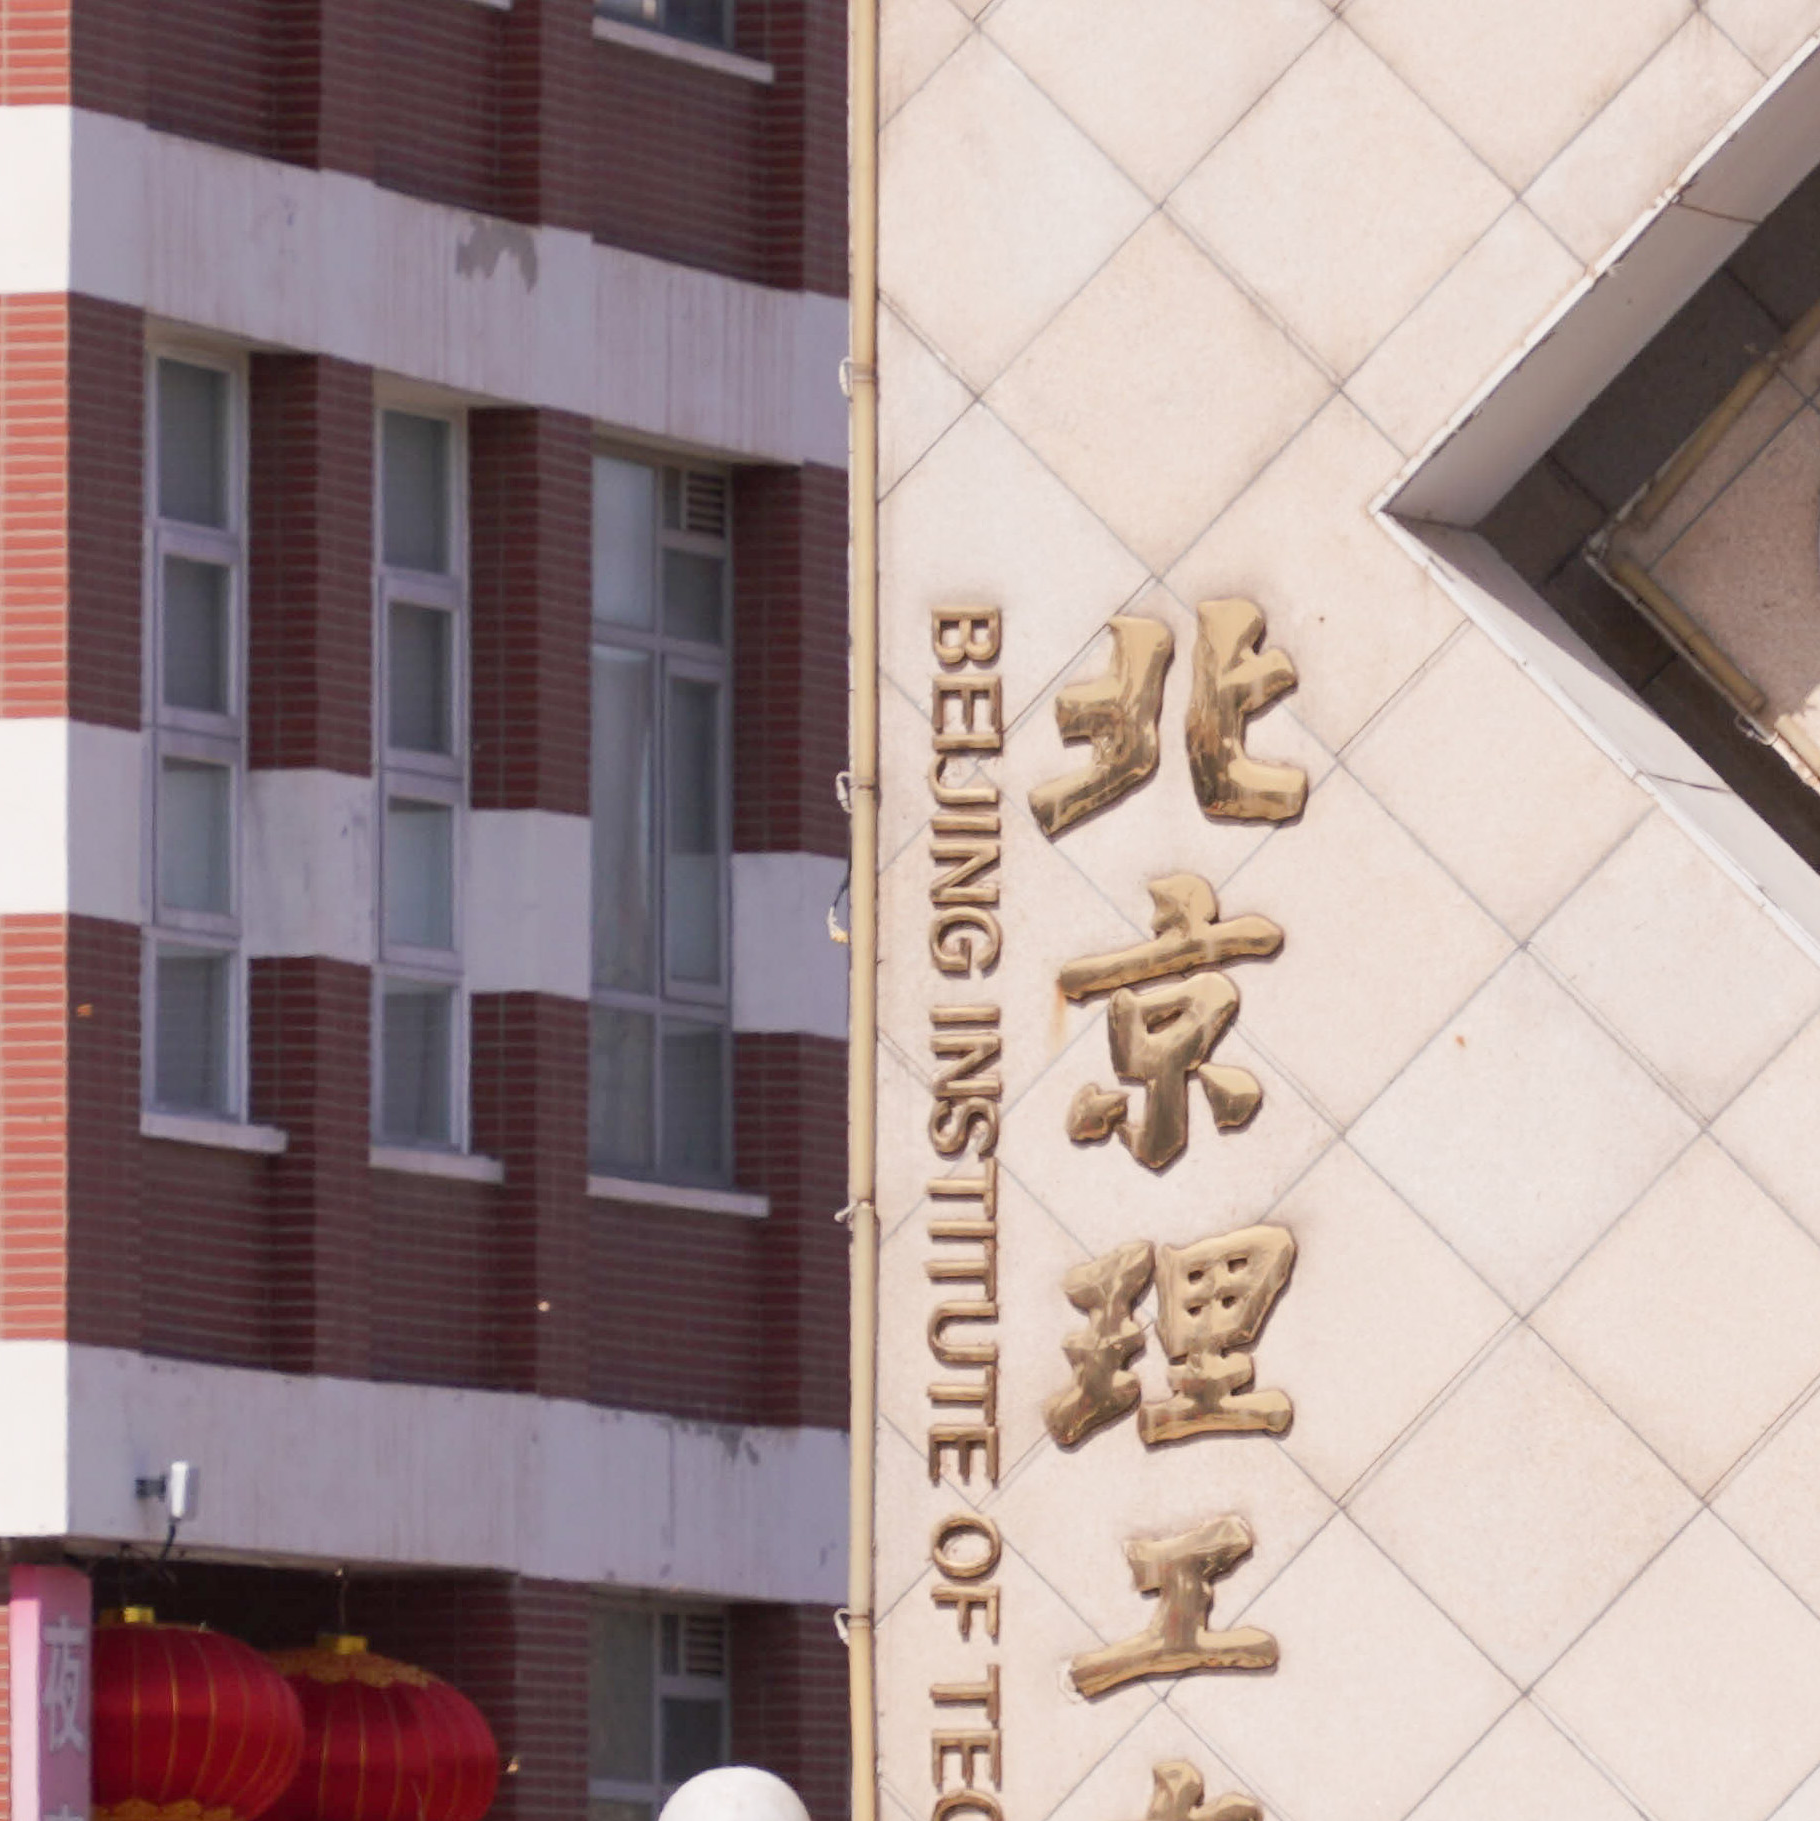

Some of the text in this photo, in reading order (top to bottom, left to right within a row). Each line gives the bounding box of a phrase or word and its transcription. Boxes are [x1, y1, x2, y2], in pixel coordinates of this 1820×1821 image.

[929, 606, 1002, 976] BEIJING
[926, 1002, 1002, 1490] INSTITUTE
[929, 1514, 1002, 1643] OF
